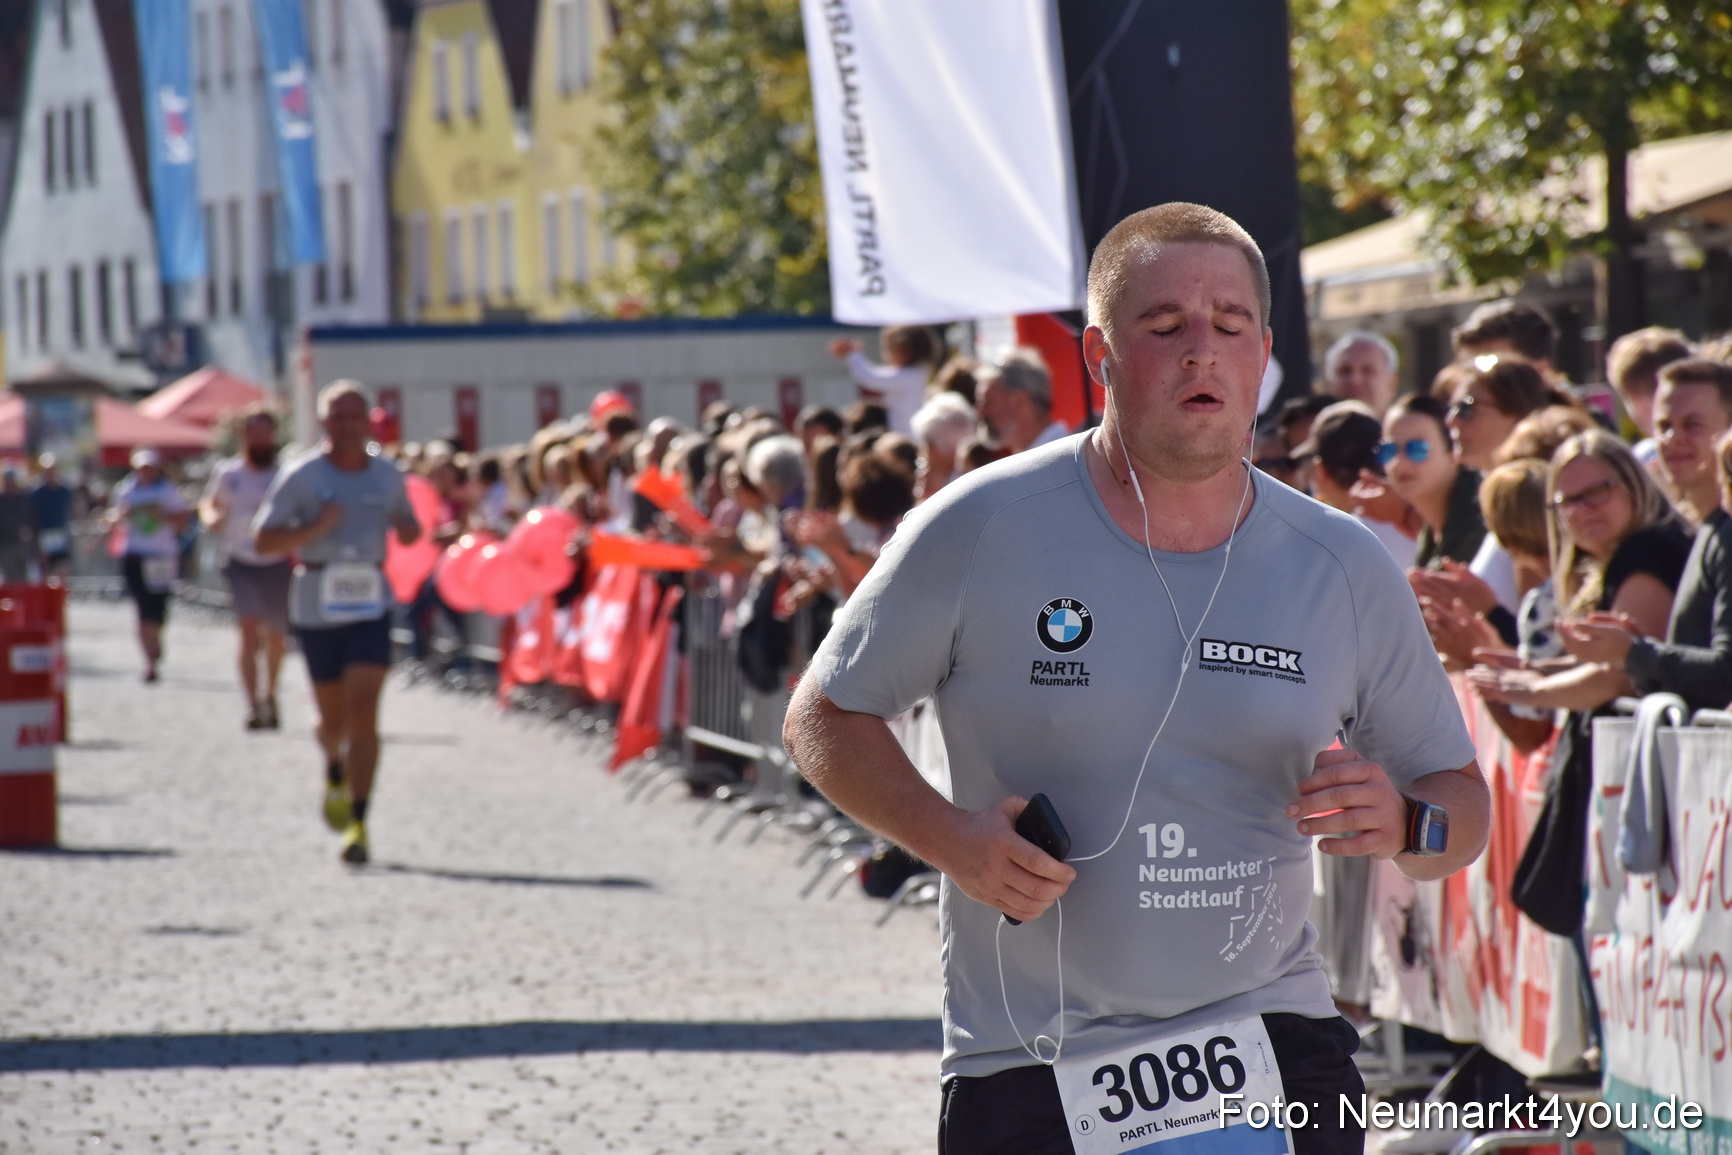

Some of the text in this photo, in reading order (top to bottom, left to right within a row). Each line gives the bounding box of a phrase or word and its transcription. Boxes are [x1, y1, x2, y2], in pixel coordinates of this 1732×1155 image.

[1202, 640, 1302, 673] BOCK
[1031, 660, 1090, 677] PARTL
[1199, 662, 1306, 685] inspired by smart concepts
[1030, 674, 1090, 687] Neumarkt
[1138, 822, 1198, 859] 19.
[1138, 859, 1263, 882] Neumarkter
[1138, 885, 1245, 909] Stadtlauf
[1223, 951, 1239, 963] 16.
[1236, 905, 1268, 952] September
[1091, 1035, 1247, 1123] 3086
[1119, 1123, 1163, 1143] PARTL
